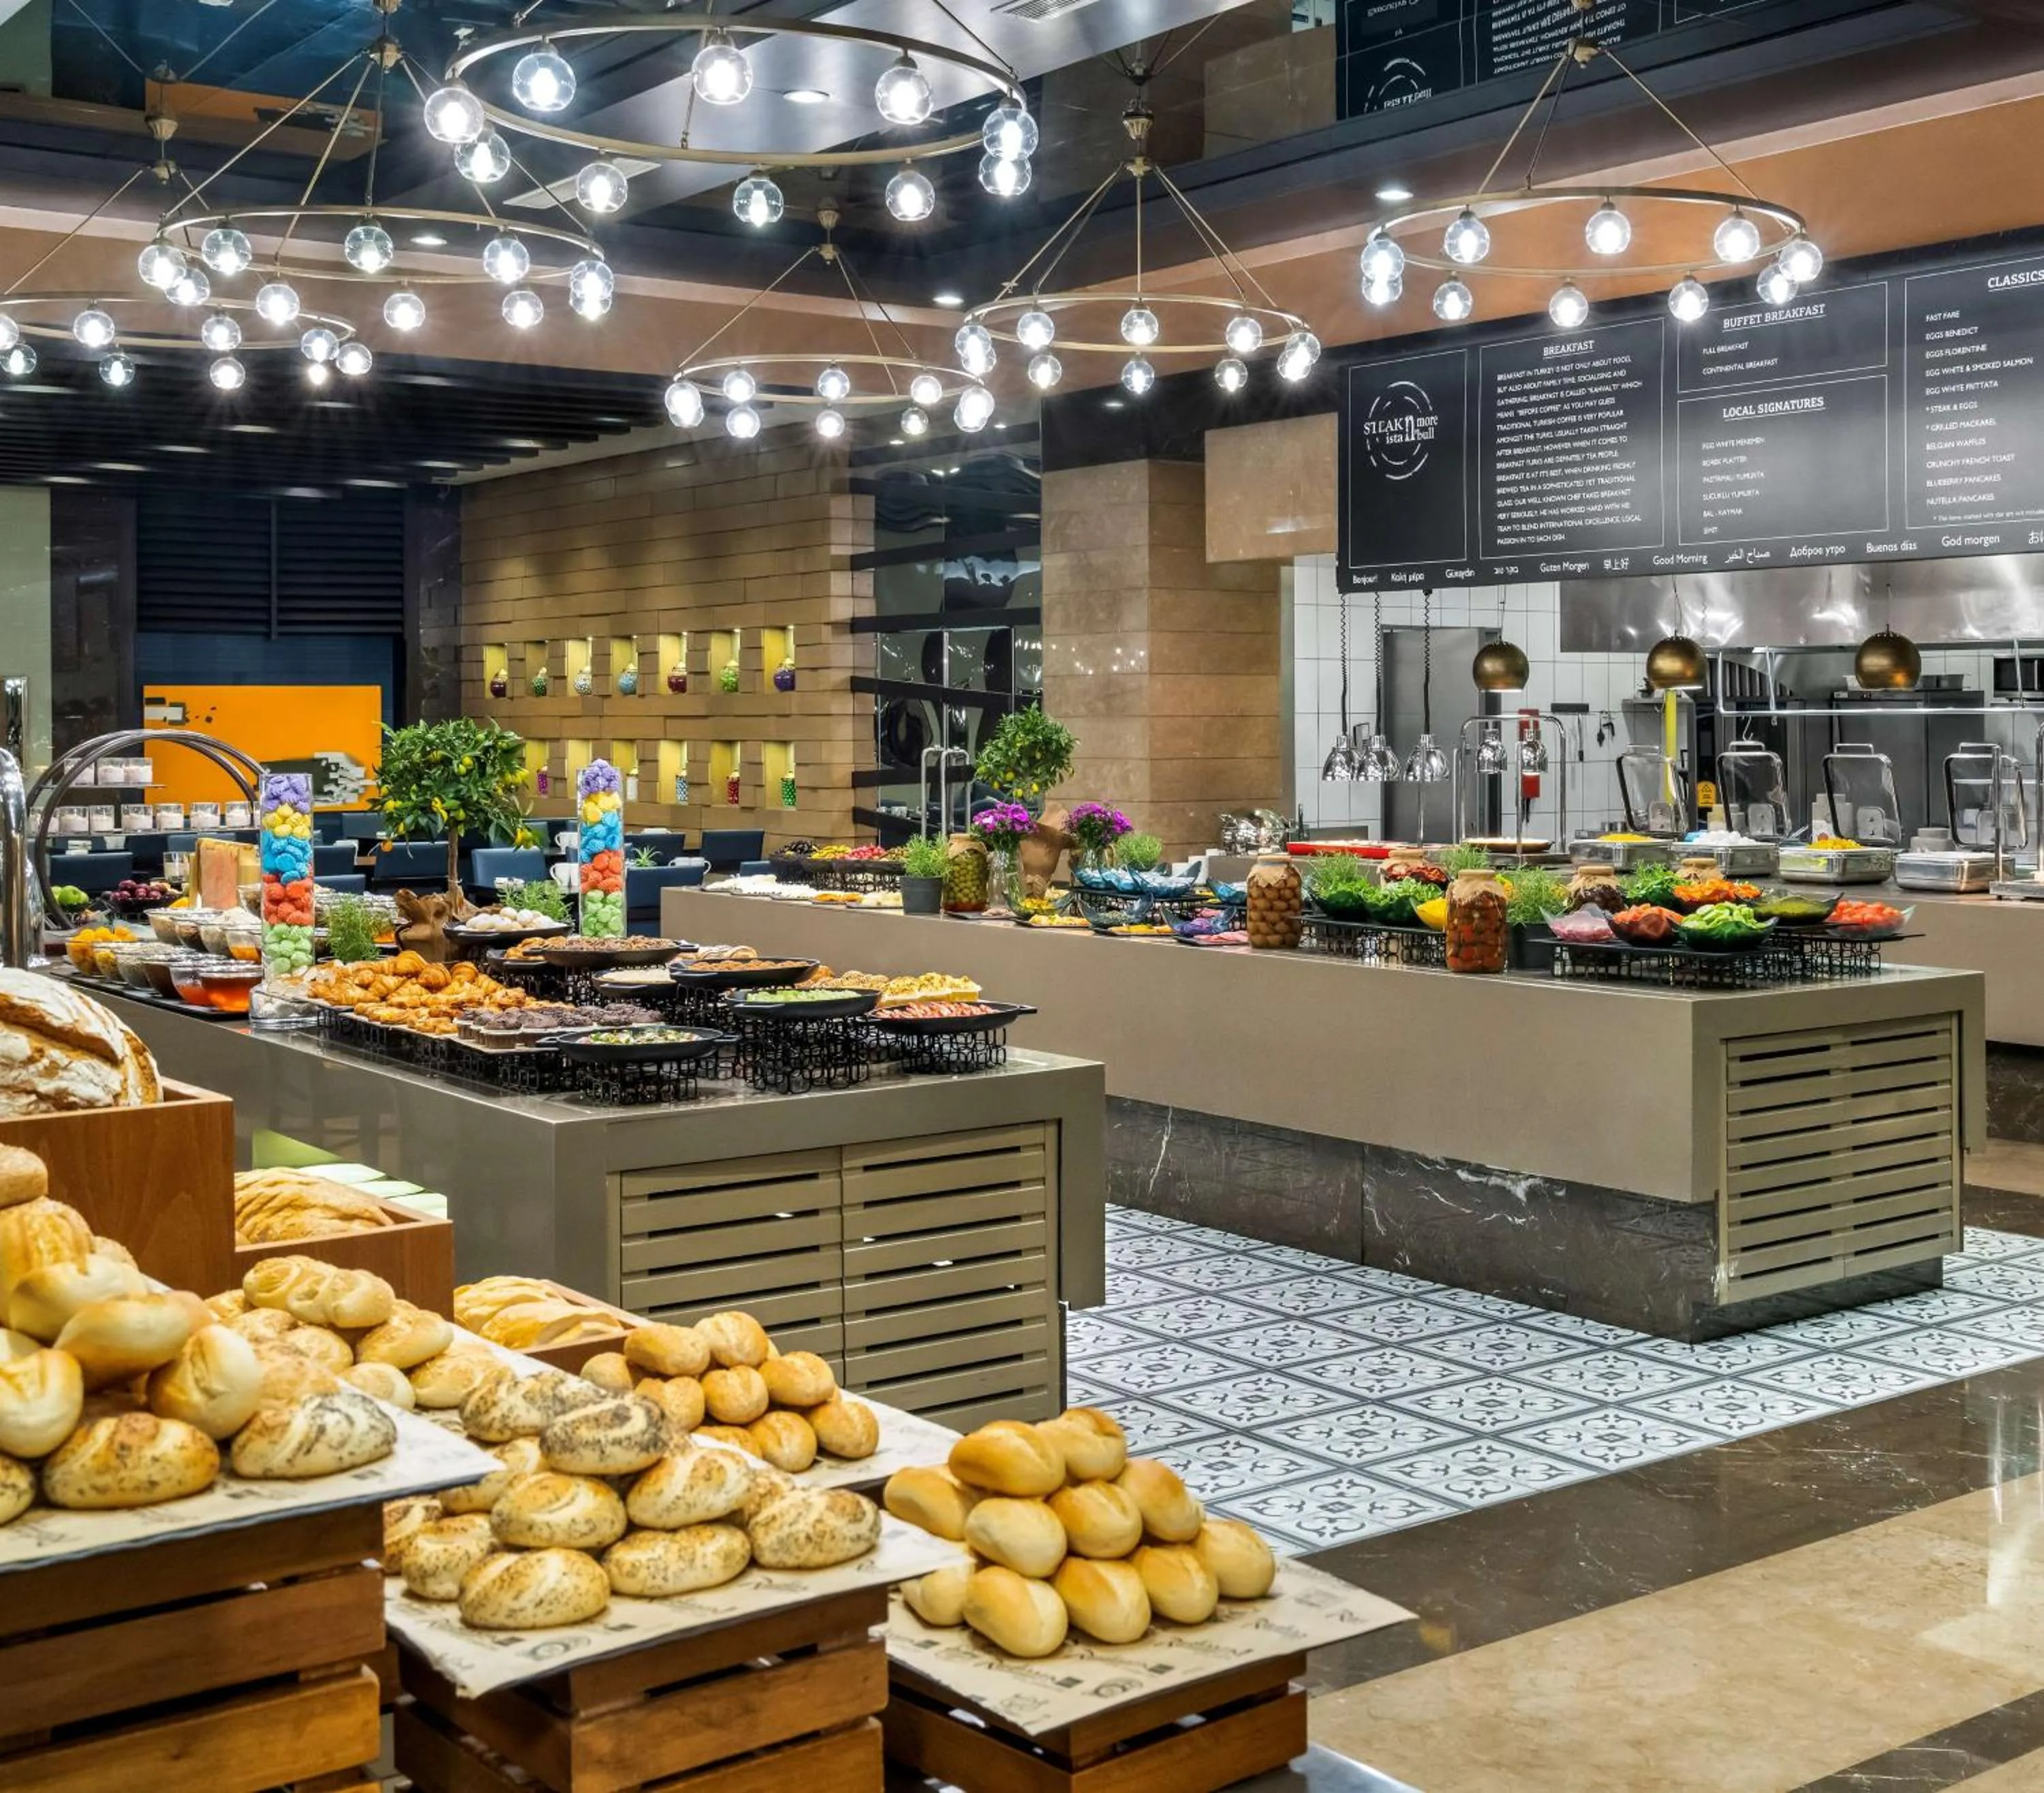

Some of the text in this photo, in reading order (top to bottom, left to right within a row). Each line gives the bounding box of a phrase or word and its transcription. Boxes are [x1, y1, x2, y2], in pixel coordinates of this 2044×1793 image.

[1987, 269, 2044, 288] CLASSICS
[1723, 304, 1826, 329] BUFFET BREAKFAST
[1925, 326, 1979, 340] EGGS BENEDICT
[1543, 341, 1595, 357] BREAKFAST
[1925, 343, 1987, 358] EGGS FLORENTINE
[1702, 362, 1744, 375] CONTINENTAL
[1925, 368, 1940, 377] EGG
[1941, 365, 1964, 375] WHITE
[1972, 360, 2000, 371] SMOKED
[2002, 356, 2033, 367] SALMON
[1925, 386, 1940, 395] EGG
[1941, 384, 1964, 393] WHITE
[1723, 396, 1824, 418] LOCAL SIGNATURES
[1363, 418, 1404, 435] STEAK
[1417, 415, 1438, 427] more
[1386, 433, 1404, 444] ista
[1992, 452, 2015, 462] TOAST
[1866, 542, 1898, 553] Buenos
[1941, 535, 2000, 547] God morgen
[1652, 552, 1708, 565] Good Morning
[1562, 561, 1590, 572] Morgen
